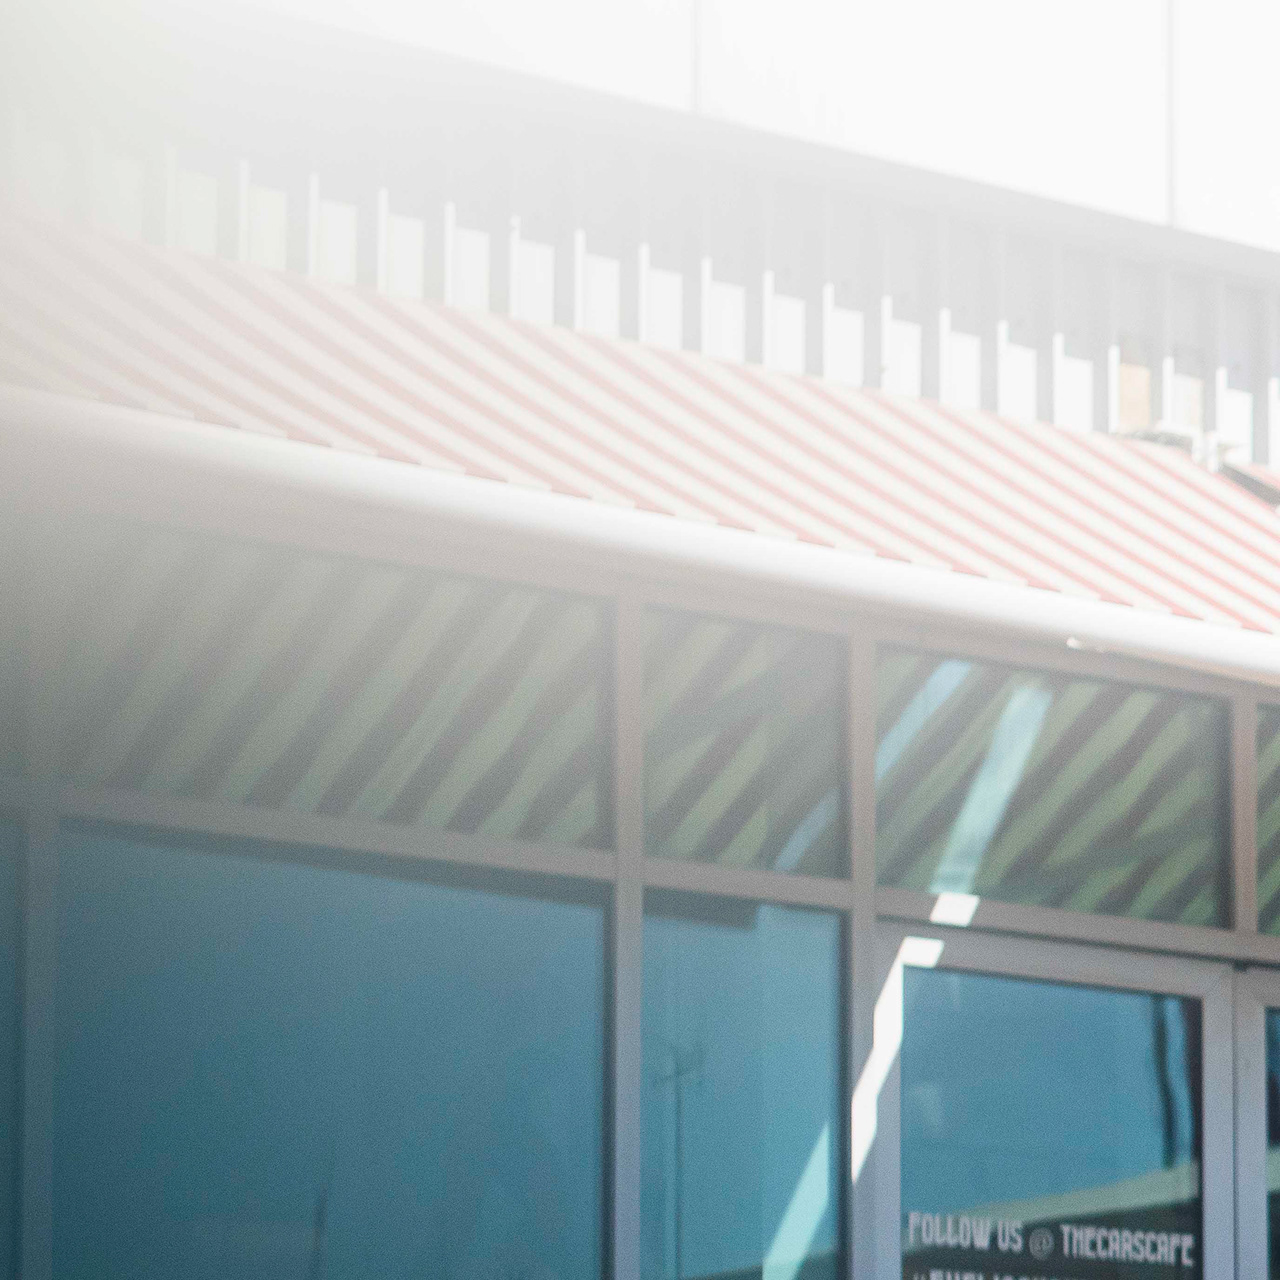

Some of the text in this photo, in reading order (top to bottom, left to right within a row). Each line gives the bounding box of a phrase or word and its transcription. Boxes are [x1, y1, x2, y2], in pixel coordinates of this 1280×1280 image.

[908, 1211, 992, 1250] FOLLOW
[996, 1218, 1023, 1253] US
[1060, 1223, 1196, 1267] THECARSCAFE
